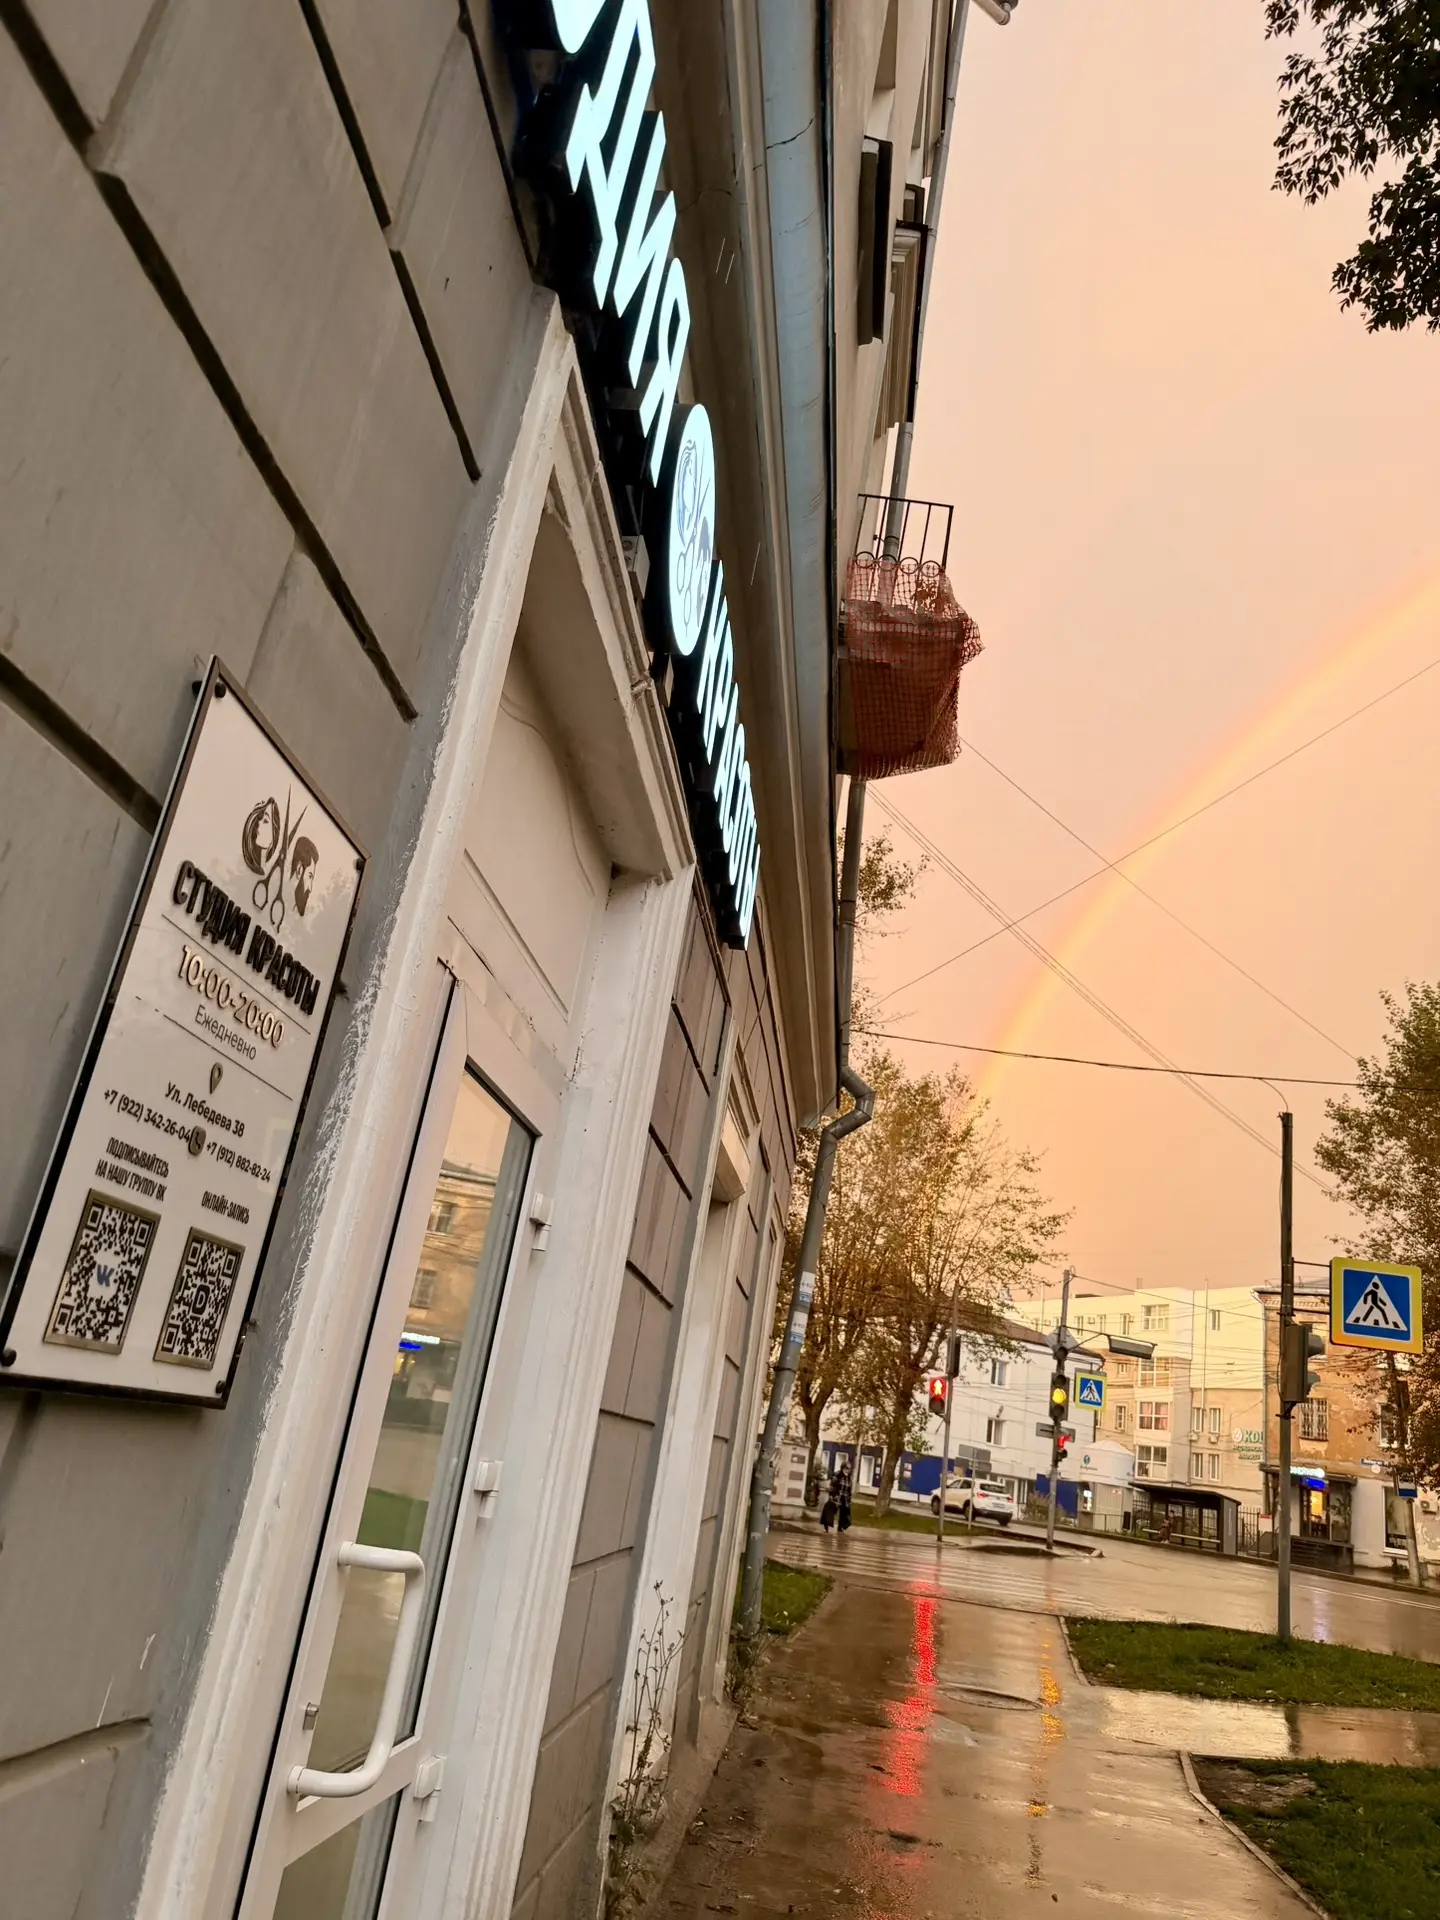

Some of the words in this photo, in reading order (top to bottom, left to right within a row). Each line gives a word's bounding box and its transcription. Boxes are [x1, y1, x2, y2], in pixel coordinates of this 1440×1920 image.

[552, 0, 690, 488] ДИЯ
[697, 559, 760, 951] КРАСОТЫ
[173, 860, 251, 955] СТУДИЯ
[246, 925, 321, 1016] КРАСОТЫ
[178, 945, 285, 1048] 10:00-20:00
[195, 1004, 257, 1060] Ежедневно
[104, 1089, 118, 1105] +7
[117, 1094, 144, 1122] (922)
[144, 1108, 191, 1143] 342-26-04
[165, 1081, 181, 1104] Ул.
[183, 1093, 232, 1132] Лебедева
[232, 1120, 245, 1137] 38
[95, 1158, 106, 1178] НА
[106, 1163, 130, 1186] НАШУ
[129, 1172, 158, 1198] ГРУППУ
[155, 1184, 168, 1201] ВК
[106, 1137, 169, 1178] ПОДПИСЫВАЙТЕСЬ
[207, 1142, 217, 1155] +7
[216, 1145, 235, 1168] (912)
[236, 1155, 272, 1183] 882-82-24
[201, 1190, 250, 1225] ОНЛАЙН-ЗАПИСЬ
